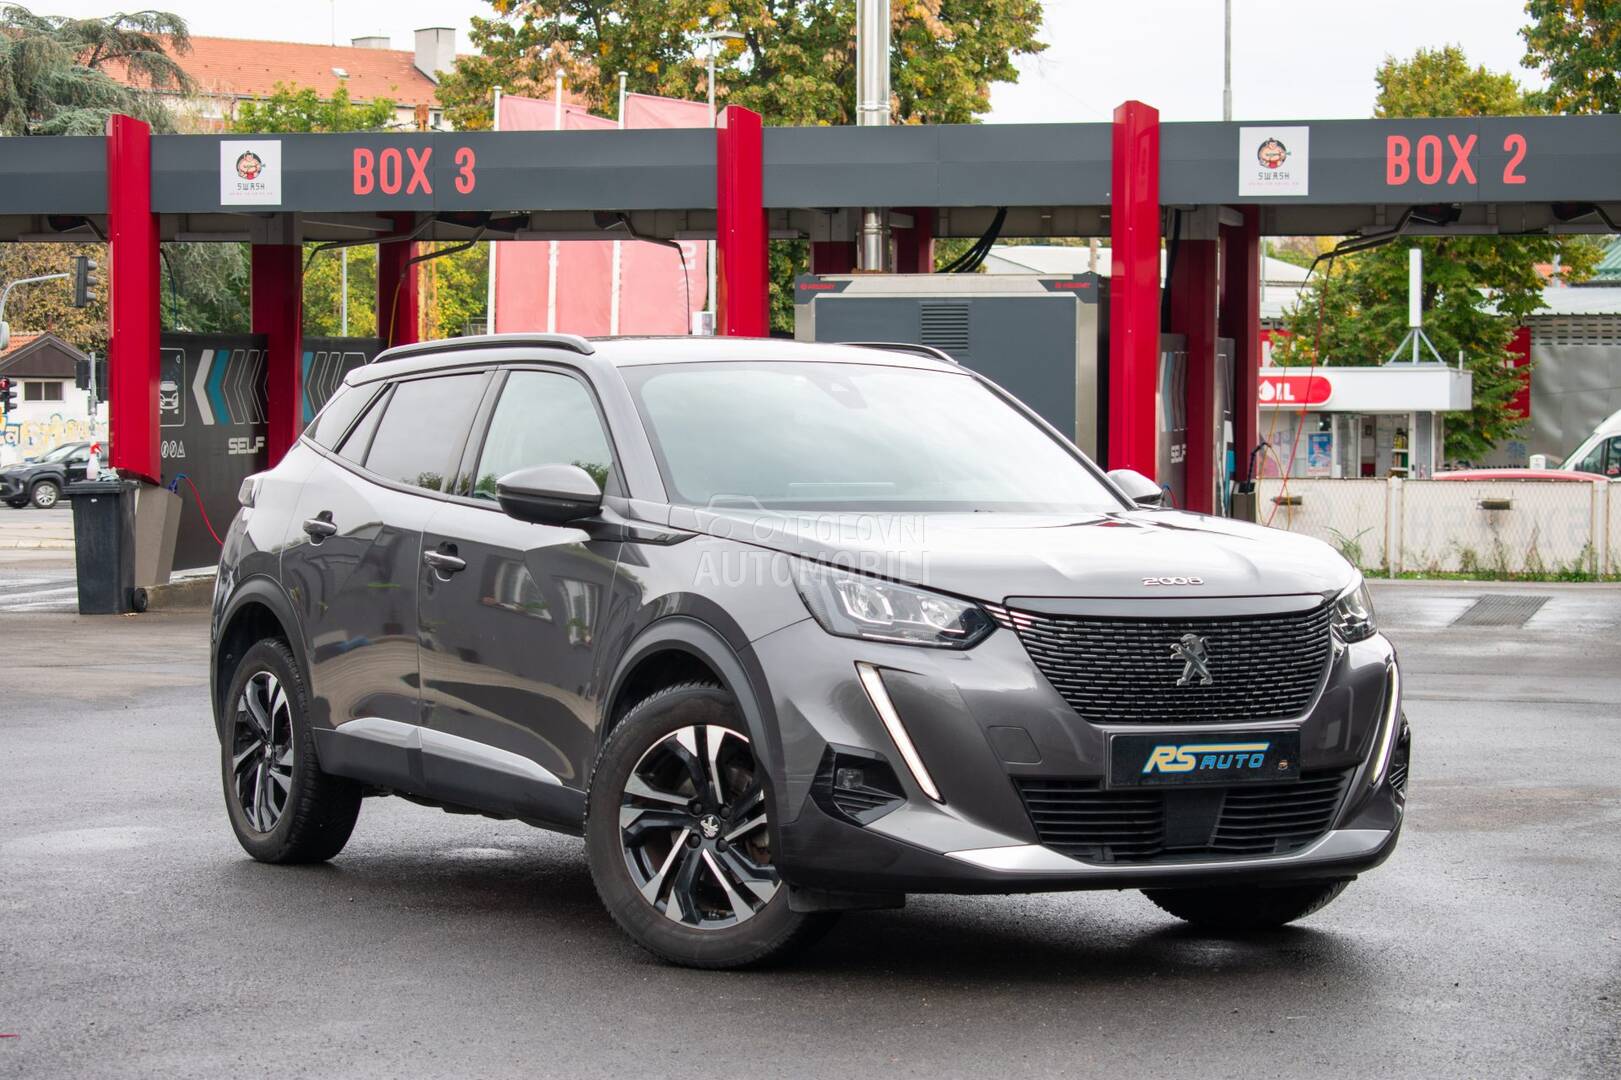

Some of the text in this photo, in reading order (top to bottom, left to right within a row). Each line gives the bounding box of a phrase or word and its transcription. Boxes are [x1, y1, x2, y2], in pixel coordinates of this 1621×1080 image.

[1386, 134, 1527, 185] BOX 2
[353, 147, 476, 195] BOX 3
[1258, 171, 1290, 180] SWASH
[237, 183, 265, 191] SWASH
[228, 436, 266, 455] SELF
[1142, 576, 1205, 587] 2008
[1142, 744, 1265, 774] RS AUTO
